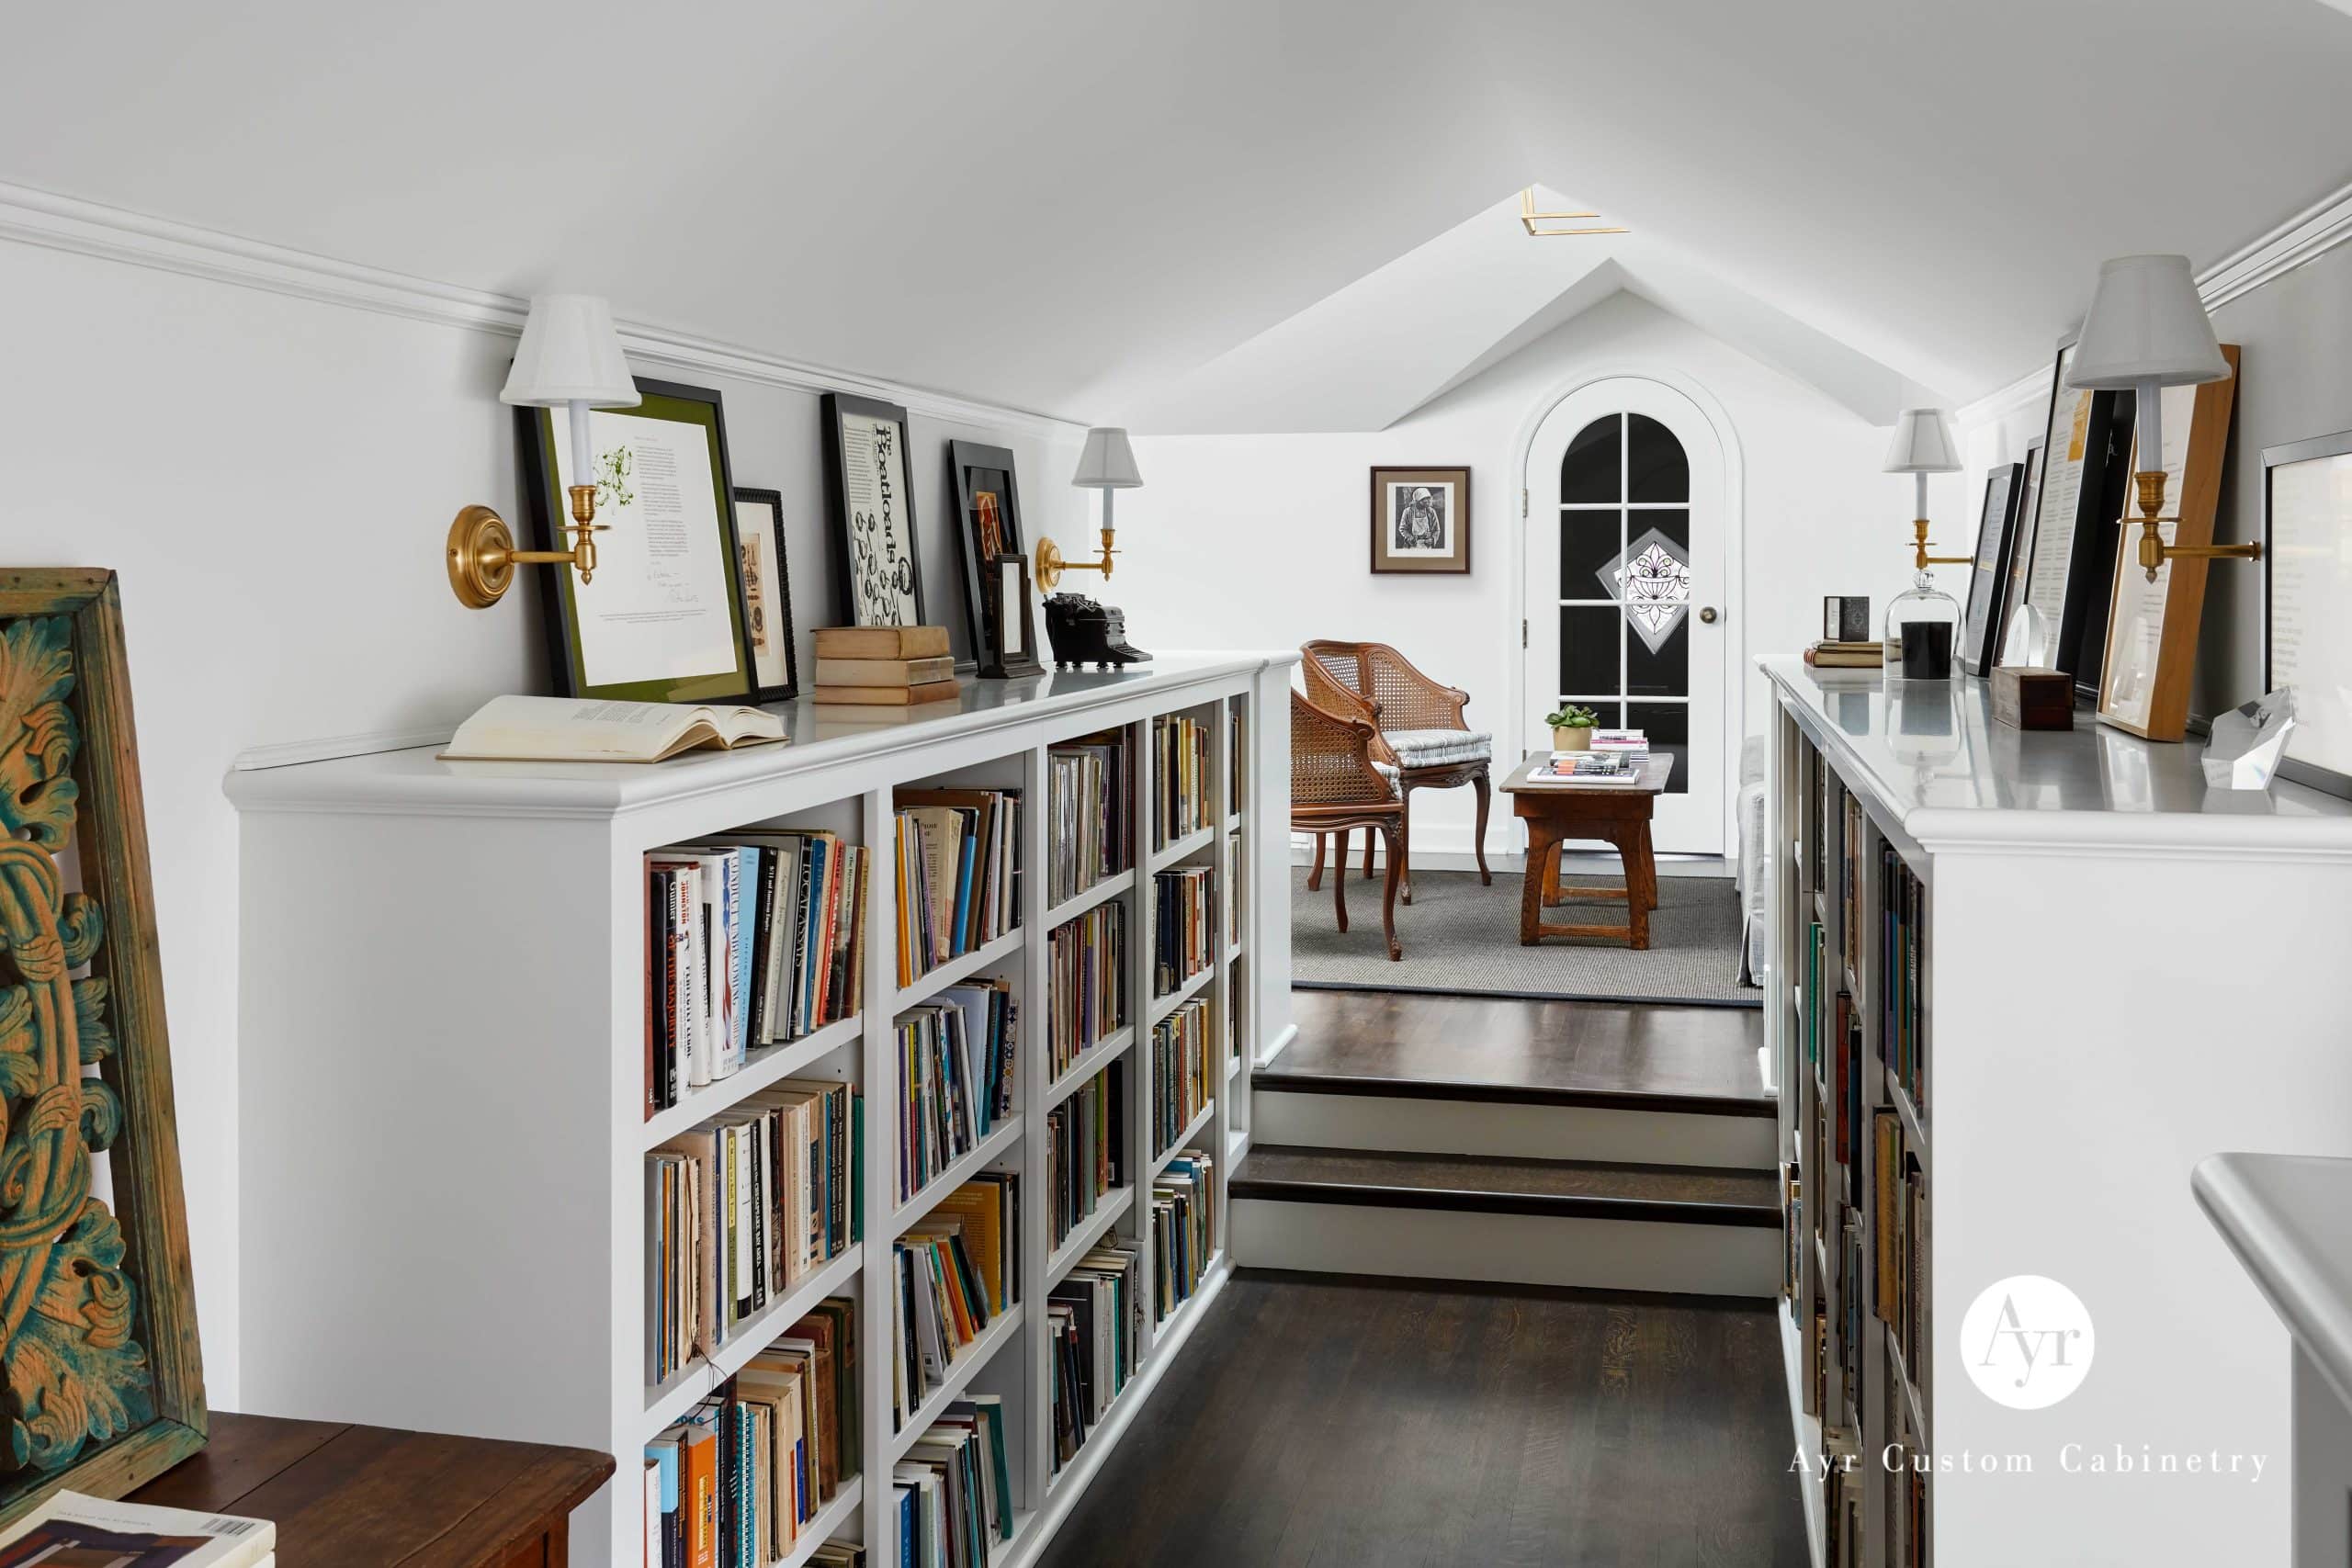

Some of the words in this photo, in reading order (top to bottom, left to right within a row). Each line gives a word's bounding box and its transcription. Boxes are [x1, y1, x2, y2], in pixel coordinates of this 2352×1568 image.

[876, 425, 897, 564] Boatloads
[669, 882, 677, 921] Guinier
[799, 863, 811, 913] LOCAL
[795, 913, 807, 968] ASSAYS
[668, 956, 677, 982] THE
[667, 984, 677, 1049] MAJORITY
